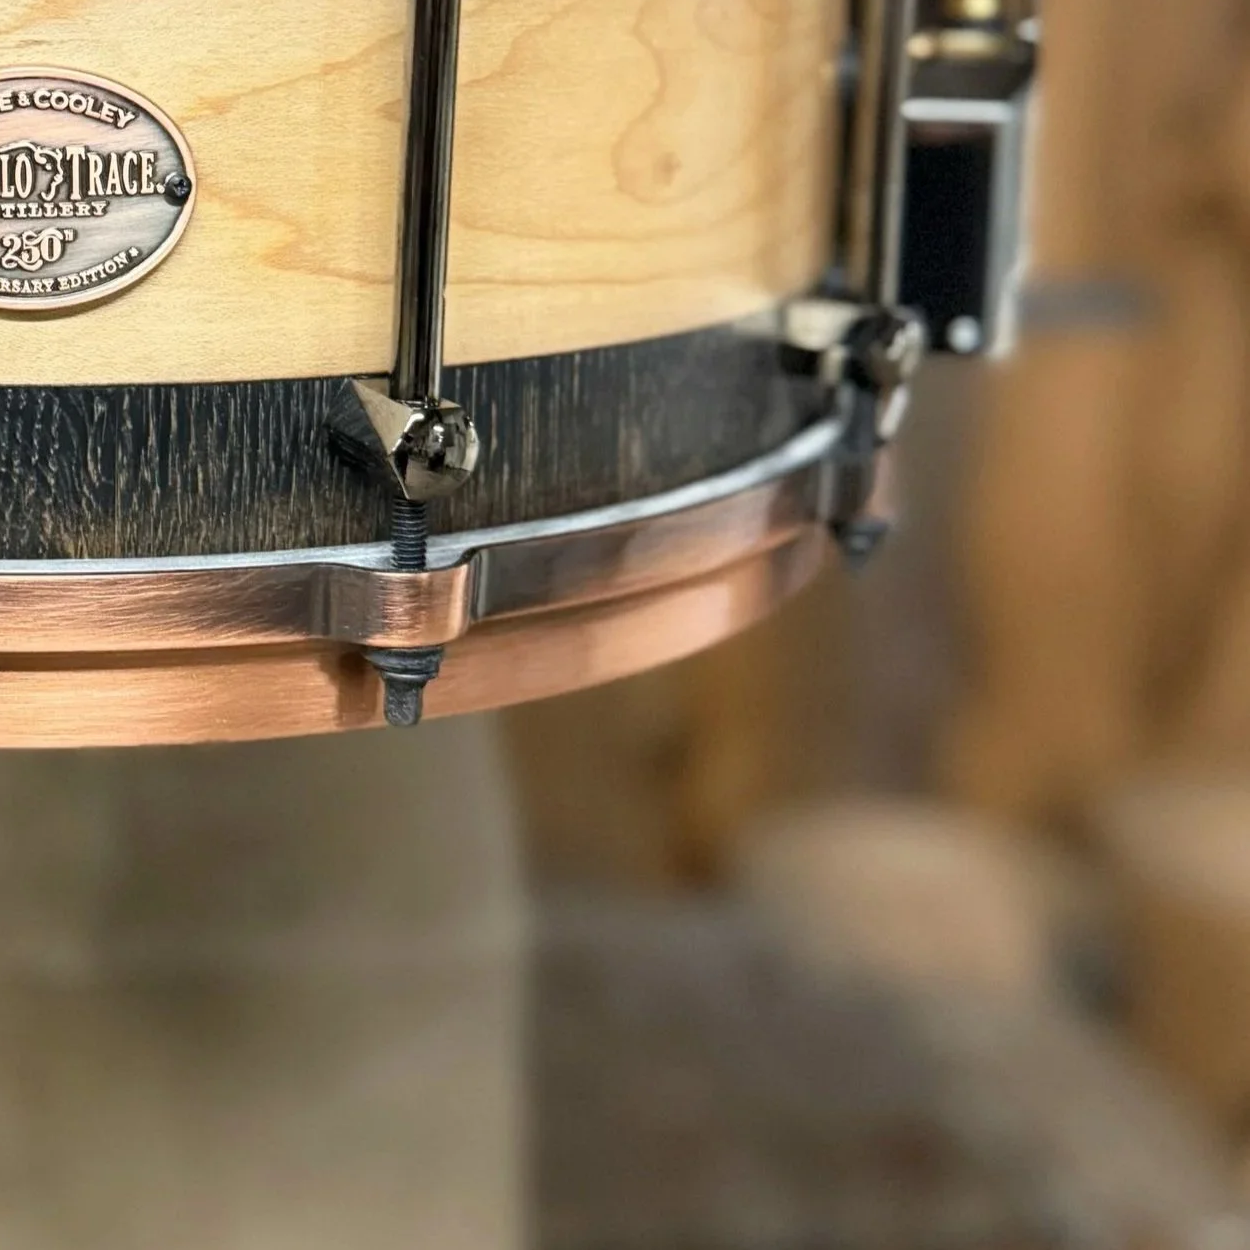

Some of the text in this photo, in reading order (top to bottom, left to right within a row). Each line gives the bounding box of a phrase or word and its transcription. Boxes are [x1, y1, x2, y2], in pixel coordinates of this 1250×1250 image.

[18, 90, 30, 107] &
[34, 90, 135, 129] COOLEY
[59, 254, 128, 289] EDITION
